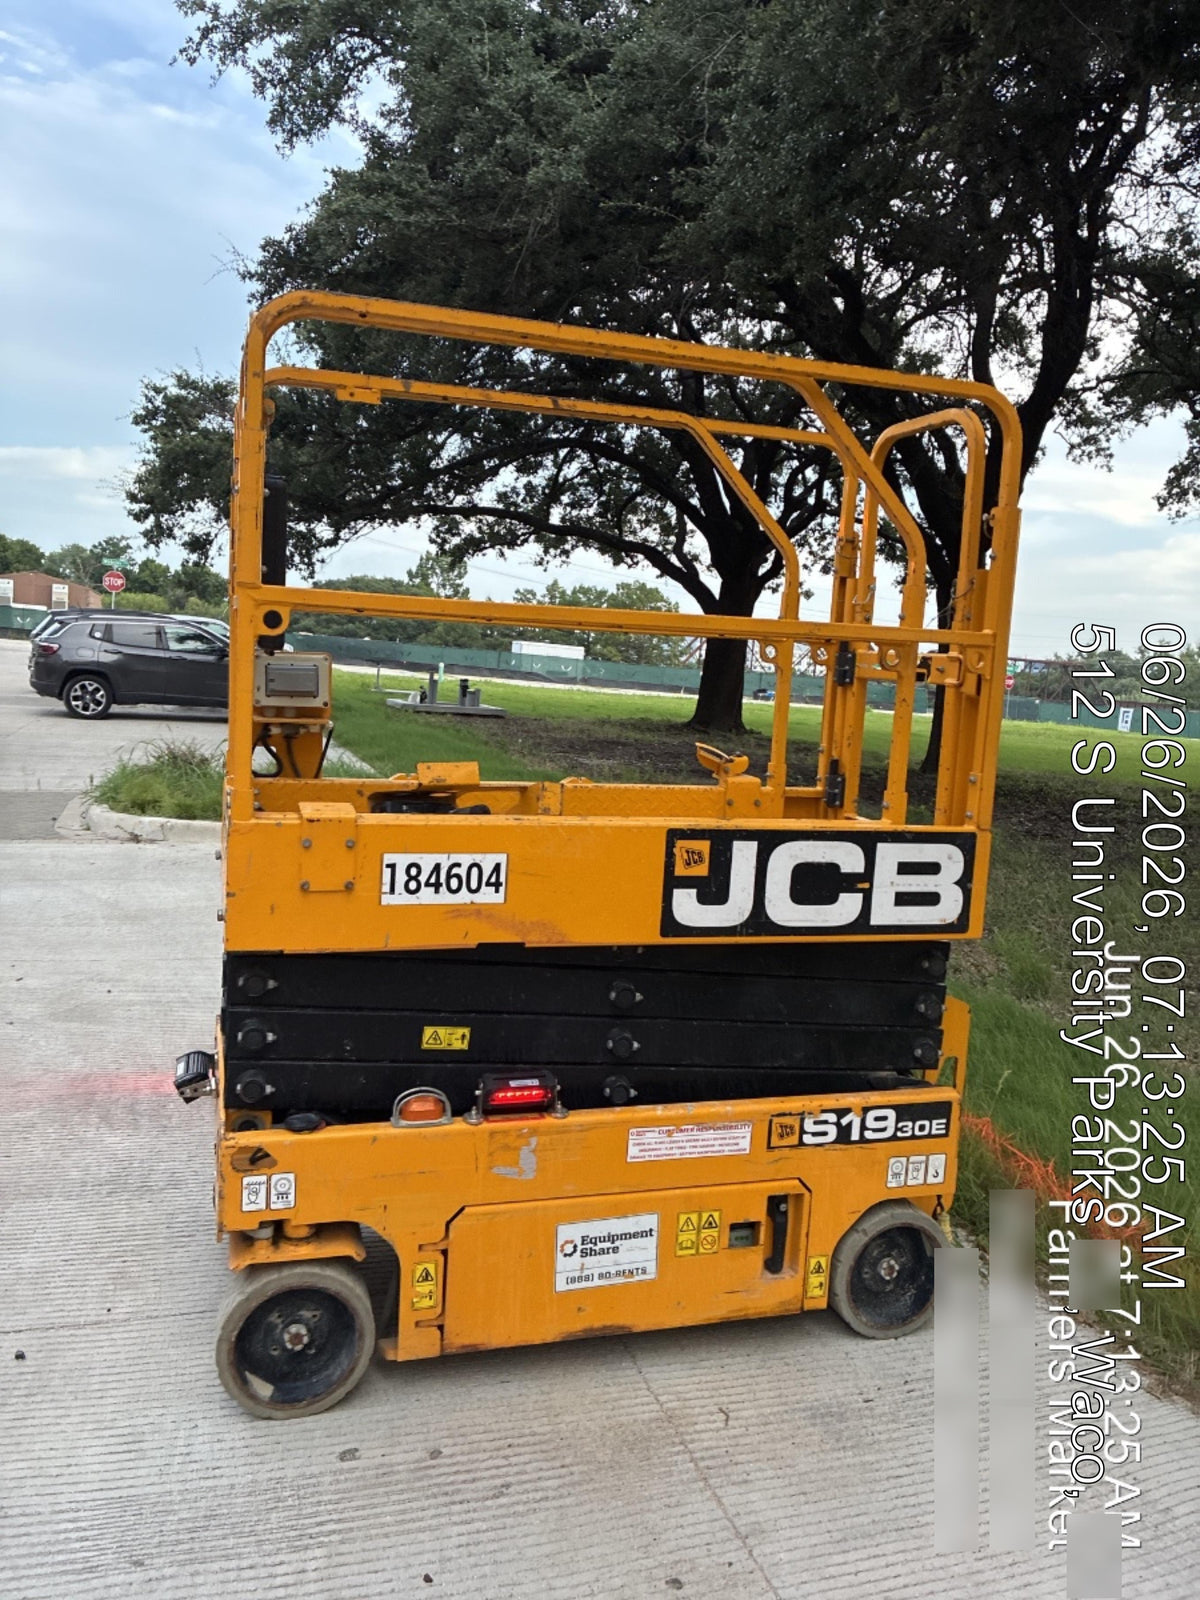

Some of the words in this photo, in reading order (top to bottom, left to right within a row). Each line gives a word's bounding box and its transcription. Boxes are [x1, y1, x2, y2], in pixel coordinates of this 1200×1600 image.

[104, 577, 124, 587] STOP
[684, 848, 705, 867] JCB
[384, 862, 504, 896] 184604
[671, 840, 966, 928] JCB
[580, 1228, 654, 1247] Equipment
[580, 1245, 620, 1258] Share
[566, 1273, 594, 1285] (888)
